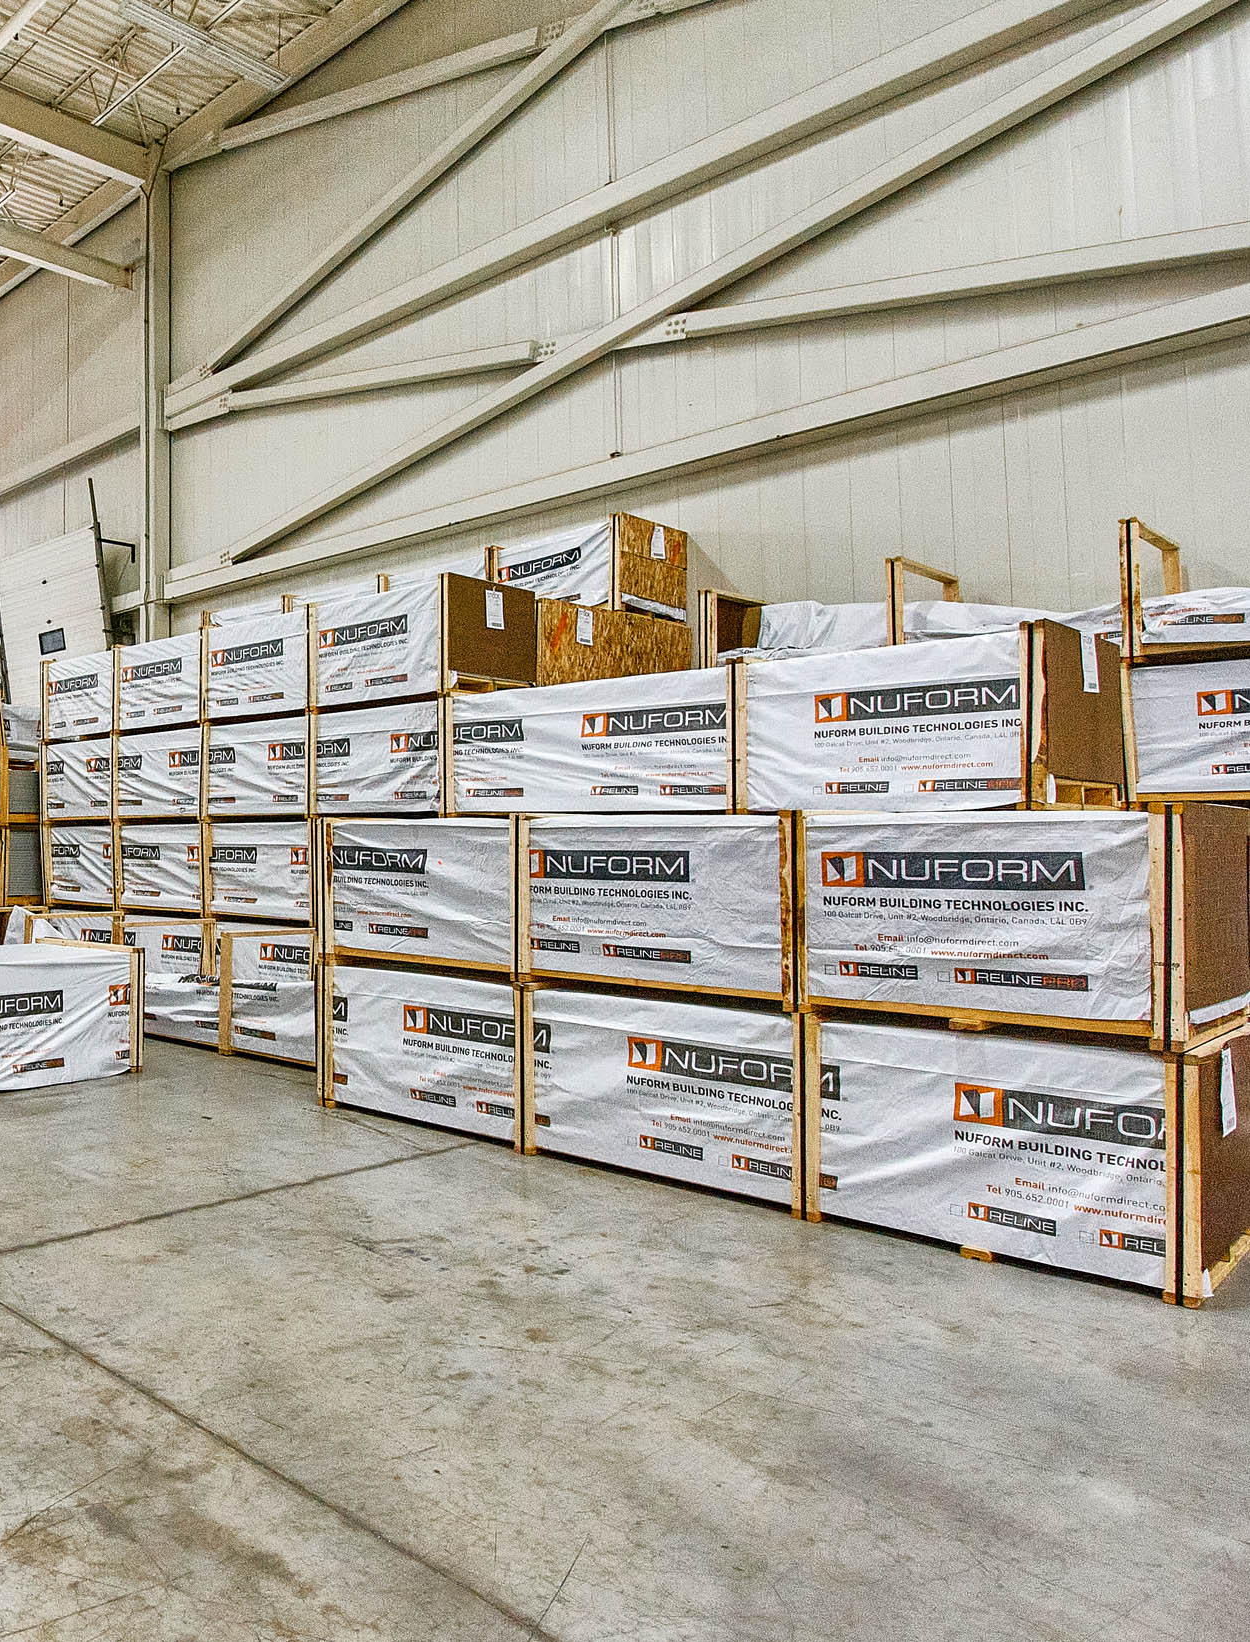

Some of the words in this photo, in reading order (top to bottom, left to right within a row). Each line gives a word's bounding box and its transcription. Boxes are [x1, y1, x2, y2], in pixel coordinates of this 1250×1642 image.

[510, 550, 579, 579] NUFORM
[335, 619, 406, 643] NUFORM
[224, 641, 282, 661] NUFORM
[134, 661, 181, 678] NUFORM
[56, 675, 97, 691] NUFORM
[851, 684, 1017, 714] NUFORM
[814, 729, 856, 739] NUFORM
[859, 725, 909, 737] BUILDING
[912, 720, 997, 732] TECHNOLOGIES
[1199, 721, 1241, 729] NUFORM
[613, 741, 652, 749] BUILDING
[655, 737, 717, 747] TECHNOLOGIES
[902, 761, 993, 772] www.nuformdirect.com
[601, 787, 637, 795] RELINE
[840, 783, 887, 792] RELINE
[547, 855, 685, 876] NUFORM
[868, 858, 1076, 882] NUFORM
[334, 876, 362, 884] BUILDING
[364, 878, 414, 887] TECHNOLOGIES
[554, 886, 595, 897] BUILDING
[598, 888, 669, 899] TECHNOLOGIES
[672, 891, 692, 900] INC.
[823, 896, 876, 907] NUFORM
[880, 898, 941, 910] BUILDING
[946, 900, 1054, 912] TECHNOLOGIES
[1059, 902, 1088, 912] INC.
[572, 916, 646, 927] info@nuformdirect.com
[921, 915, 972, 924] Woodbridge,
[974, 916, 1008, 925] Ontario,
[1012, 917, 1048, 925] Canada,
[1070, 918, 1087, 926] 0B9
[539, 941, 578, 951] RELINE
[878, 934, 903, 942] Email
[907, 934, 1018, 947] info@nuformdirect.com
[274, 948, 309, 962] NUFO
[931, 950, 1048, 960] www.nuformdirect.com
[858, 965, 917, 977] RELINE
[976, 972, 1086, 989] RELINEPRO
[336, 1027, 348, 1036] INC.
[403, 1037, 433, 1050] NUFORM
[435, 1043, 470, 1056] BUILDING
[535, 1059, 552, 1069] INC.
[627, 1075, 670, 1091] NUFORM
[673, 1082, 725, 1100] BUILDING
[421, 1092, 455, 1105] RELINE
[652, 1119, 662, 1127] Tel
[1009, 1097, 1165, 1140] NUFO
[671, 1114, 691, 1123] Email
[693, 1118, 785, 1142] info@nuformdirect.com
[655, 1141, 702, 1159] RELINE
[954, 1129, 1013, 1149] NUFORM
[1019, 1140, 1092, 1161] BUILDING
[969, 1148, 996, 1160] Galcat
[999, 1152, 1026, 1164] Drive,
[1028, 1156, 1047, 1167] Unit
[1050, 1161, 1064, 1171] #2,
[1126, 1174, 1165, 1186] Ontario,
[1016, 1177, 1044, 1191] Email
[987, 1184, 1001, 1195] Tel
[1004, 1188, 1068, 1208] 905.652.0001
[989, 1210, 1054, 1232] RELINE
